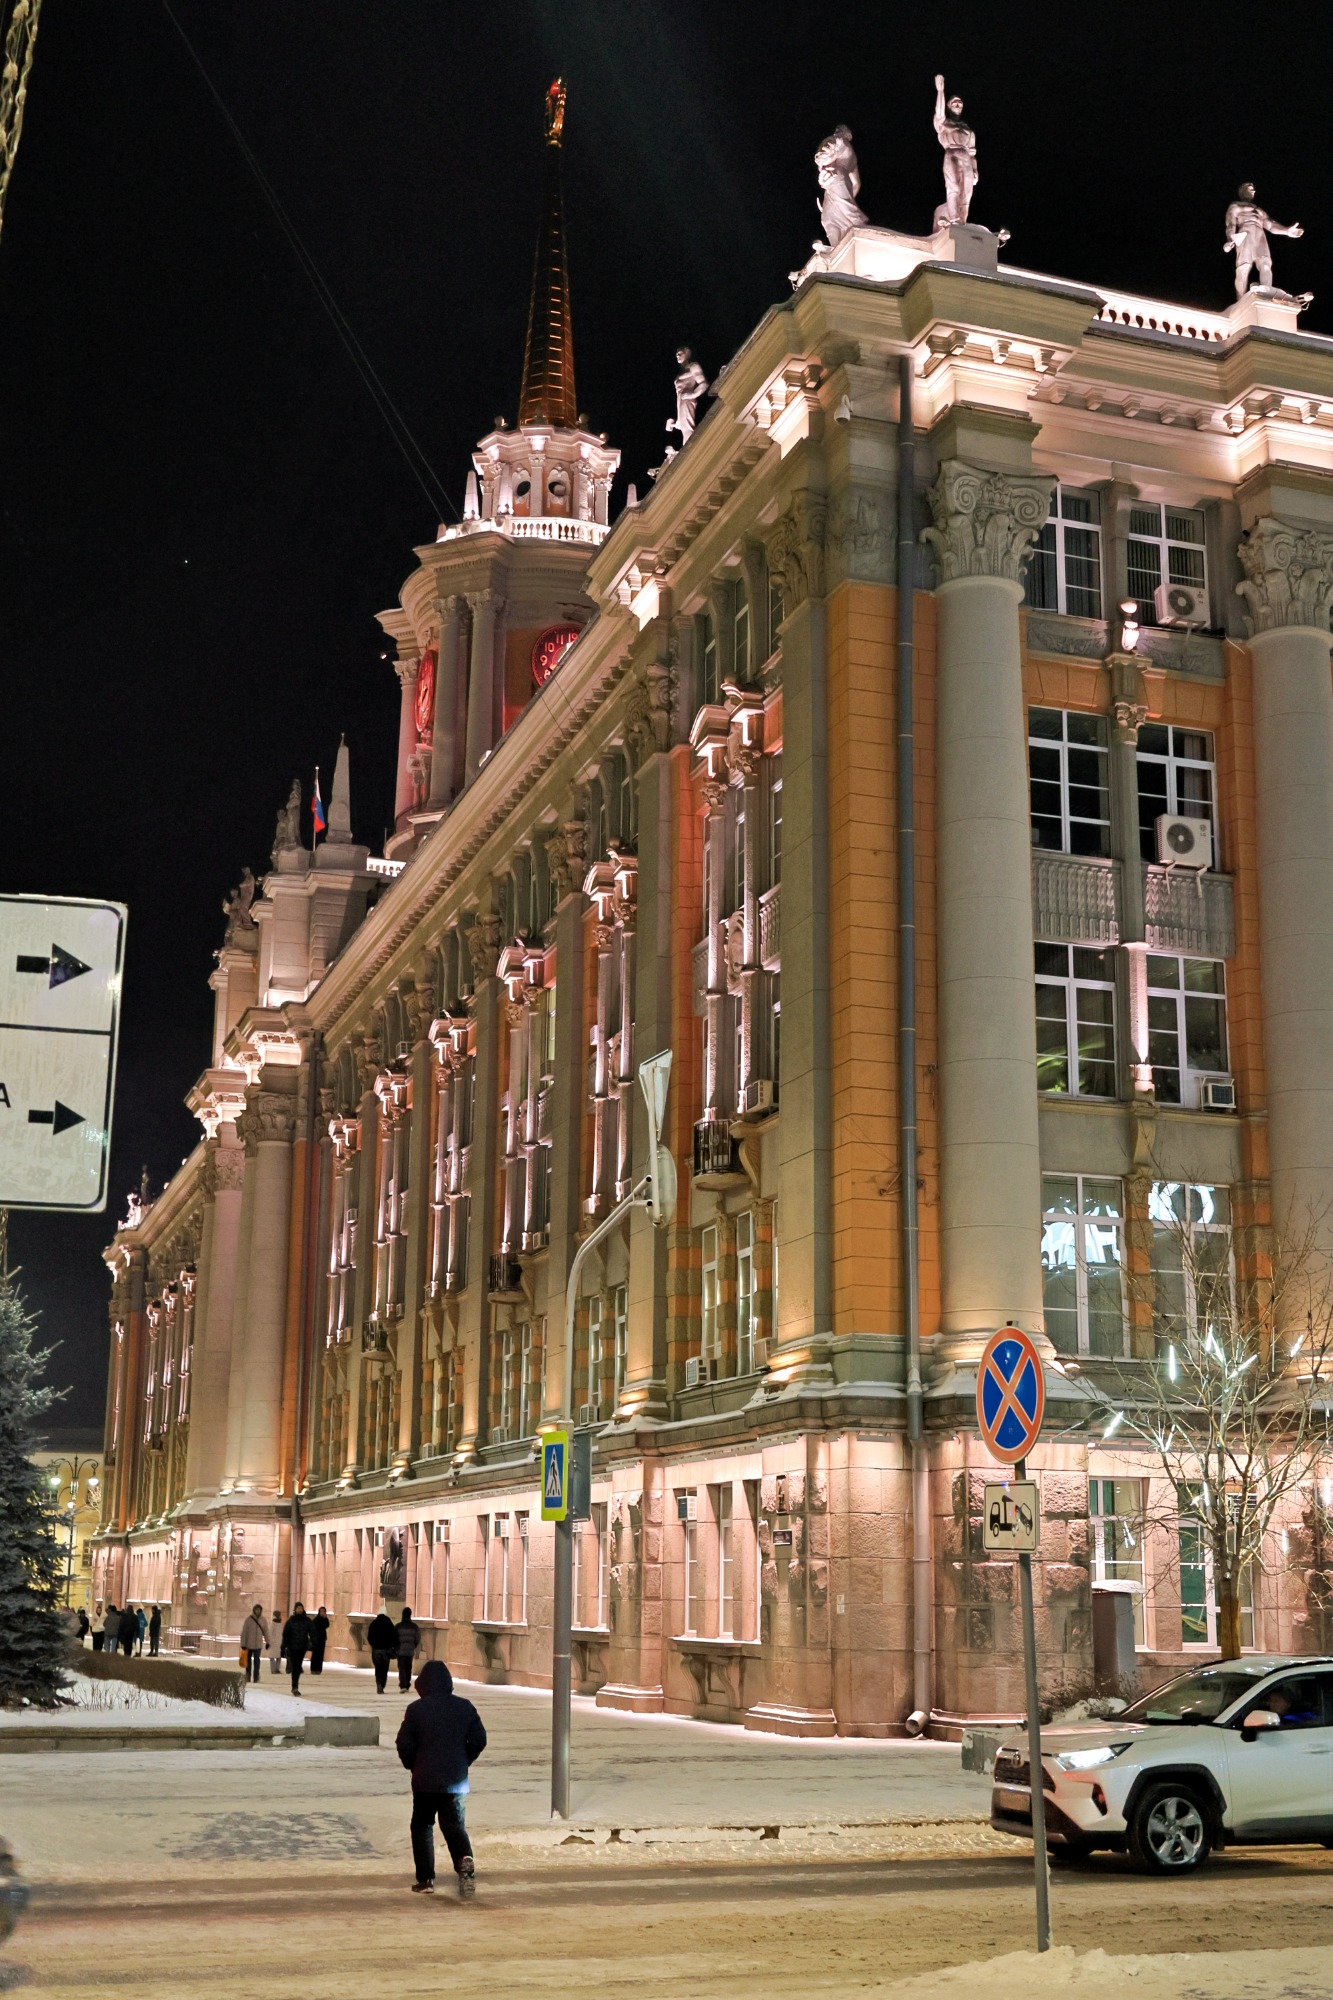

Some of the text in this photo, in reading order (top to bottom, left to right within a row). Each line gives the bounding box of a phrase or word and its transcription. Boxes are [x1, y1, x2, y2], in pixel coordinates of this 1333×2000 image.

[556, 634, 564, 645] 11
[544, 642, 555, 652] 10
[540, 655, 548, 666] 9
